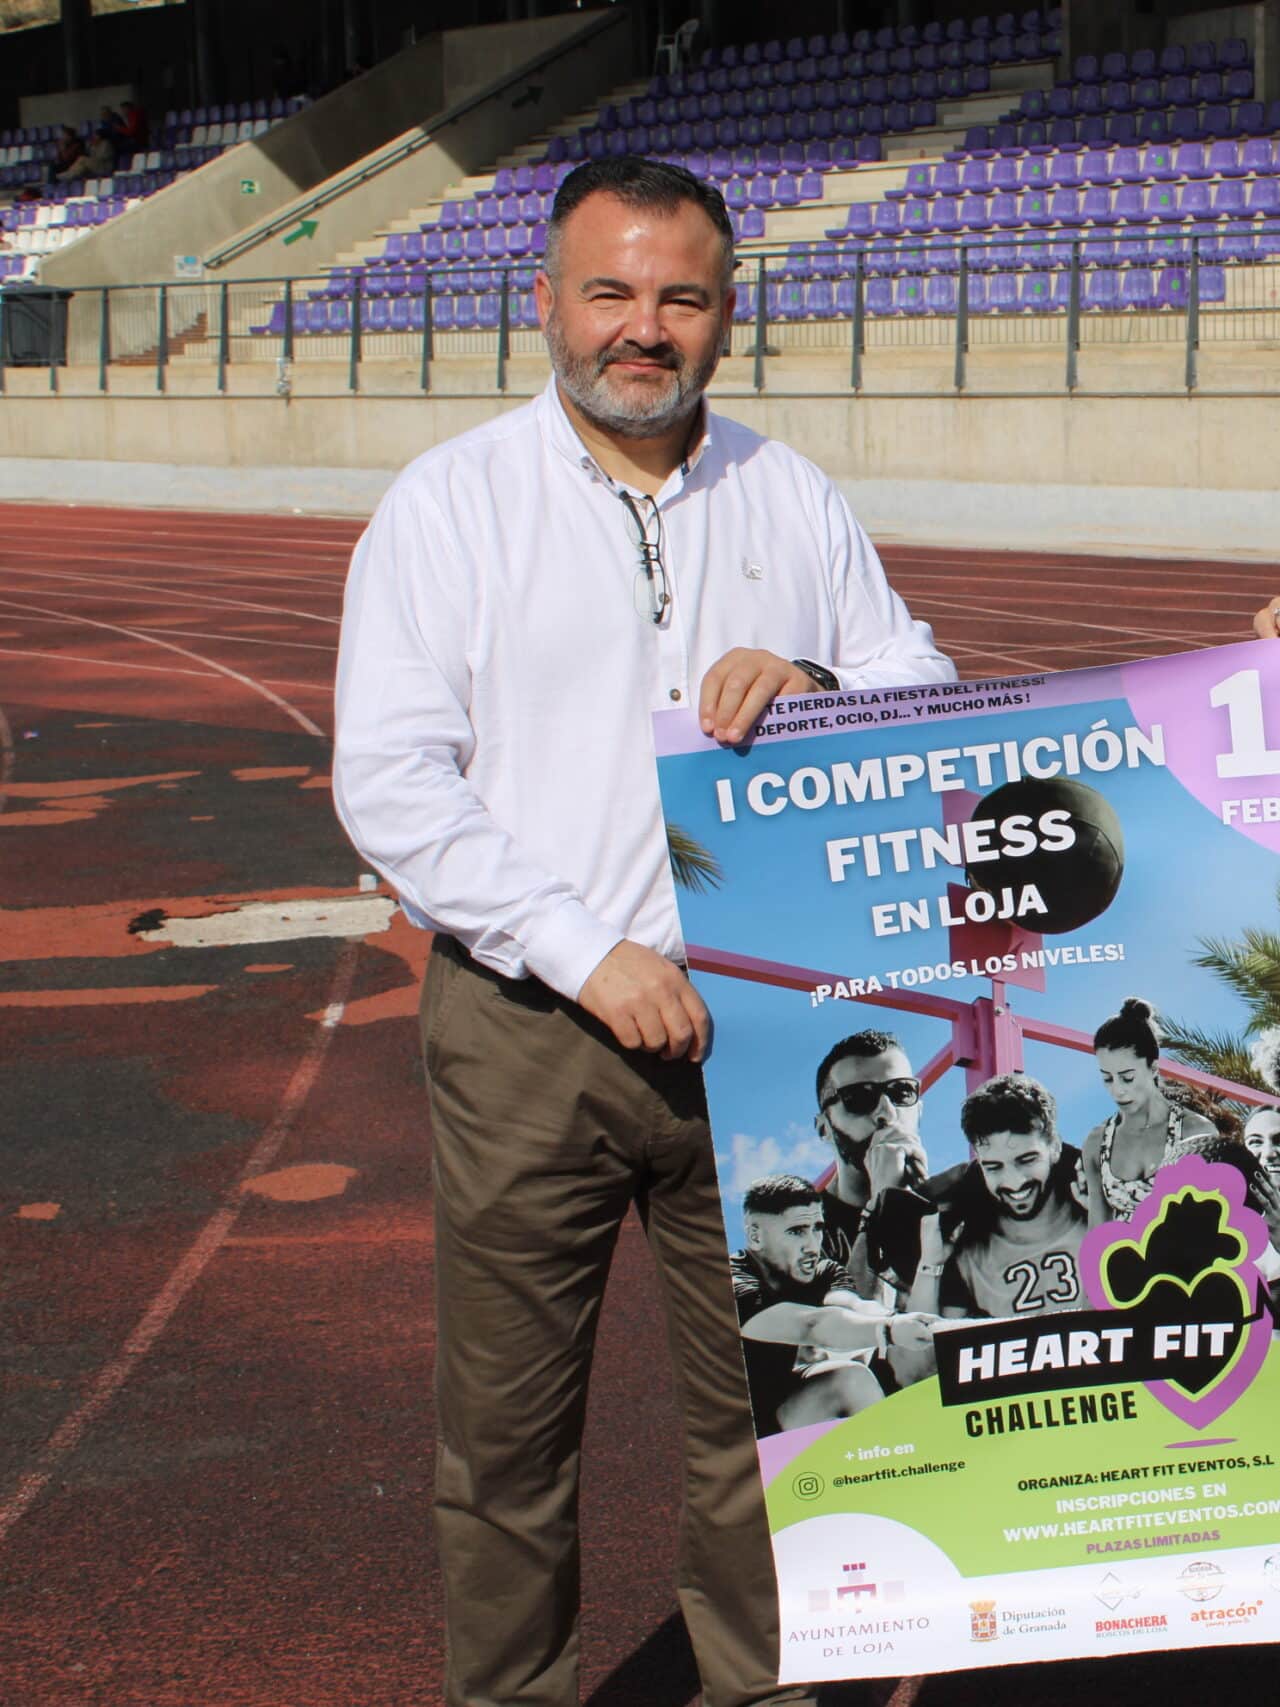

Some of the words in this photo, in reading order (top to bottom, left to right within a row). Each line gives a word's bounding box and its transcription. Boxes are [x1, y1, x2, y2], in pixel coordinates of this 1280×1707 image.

[767, 703, 785, 715] TE
[788, 696, 857, 712] PIERDAS
[860, 694, 881, 705] LA
[885, 688, 939, 703] FIESTA
[943, 685, 973, 696] DEL
[976, 676, 1046, 693] FITNESS!
[755, 717, 833, 738] DEPORTE,
[836, 711, 878, 726] OCIO,
[880, 709, 911, 721] DJ...
[913, 706, 924, 716] Y
[927, 698, 985, 715] MUCHO
[715, 778, 736, 823] I
[746, 718, 1166, 816] COMPETICIÓN
[826, 809, 1077, 882] FITNESS
[871, 898, 930, 937] EN
[939, 884, 1048, 927] LOJA
[810, 975, 883, 1008] ¡PARA
[887, 960, 968, 989] TODOS
[970, 954, 1017, 977] LOS
[1022, 943, 1126, 969] NIVELES!
[1003, 1251, 1079, 1313] 23
[957, 1328, 1133, 1384] HEART
[1153, 1322, 1234, 1360] FIT
[965, 1390, 1138, 1438] CHALLENGE
[858, 1445, 890, 1461] info
[894, 1443, 915, 1456] en
[833, 1460, 966, 1488] @heartfit.challenge
[1018, 1473, 1099, 1491] ORGANIZA:
[1101, 1467, 1150, 1482] HEART
[1153, 1464, 1176, 1477] FIT
[1178, 1457, 1251, 1474] EVENTOS,
[1252, 1454, 1275, 1467] S.L
[1056, 1486, 1196, 1513] INSCRIPCIONES
[1203, 1483, 1227, 1498] EN
[1086, 1538, 1143, 1554] PLAZAS
[1144, 1530, 1221, 1548] LIMITADAS
[788, 1616, 930, 1642] AYUNTAMIENTO
[1002, 1606, 1066, 1623] Diputación
[1002, 1625, 1015, 1636] de
[1018, 1621, 1067, 1635] Granada
[1096, 1615, 1168, 1632] BONACHERA
[1191, 1602, 1257, 1623] atracón
[822, 1646, 844, 1658] DE
[852, 1641, 895, 1655] LOJA
